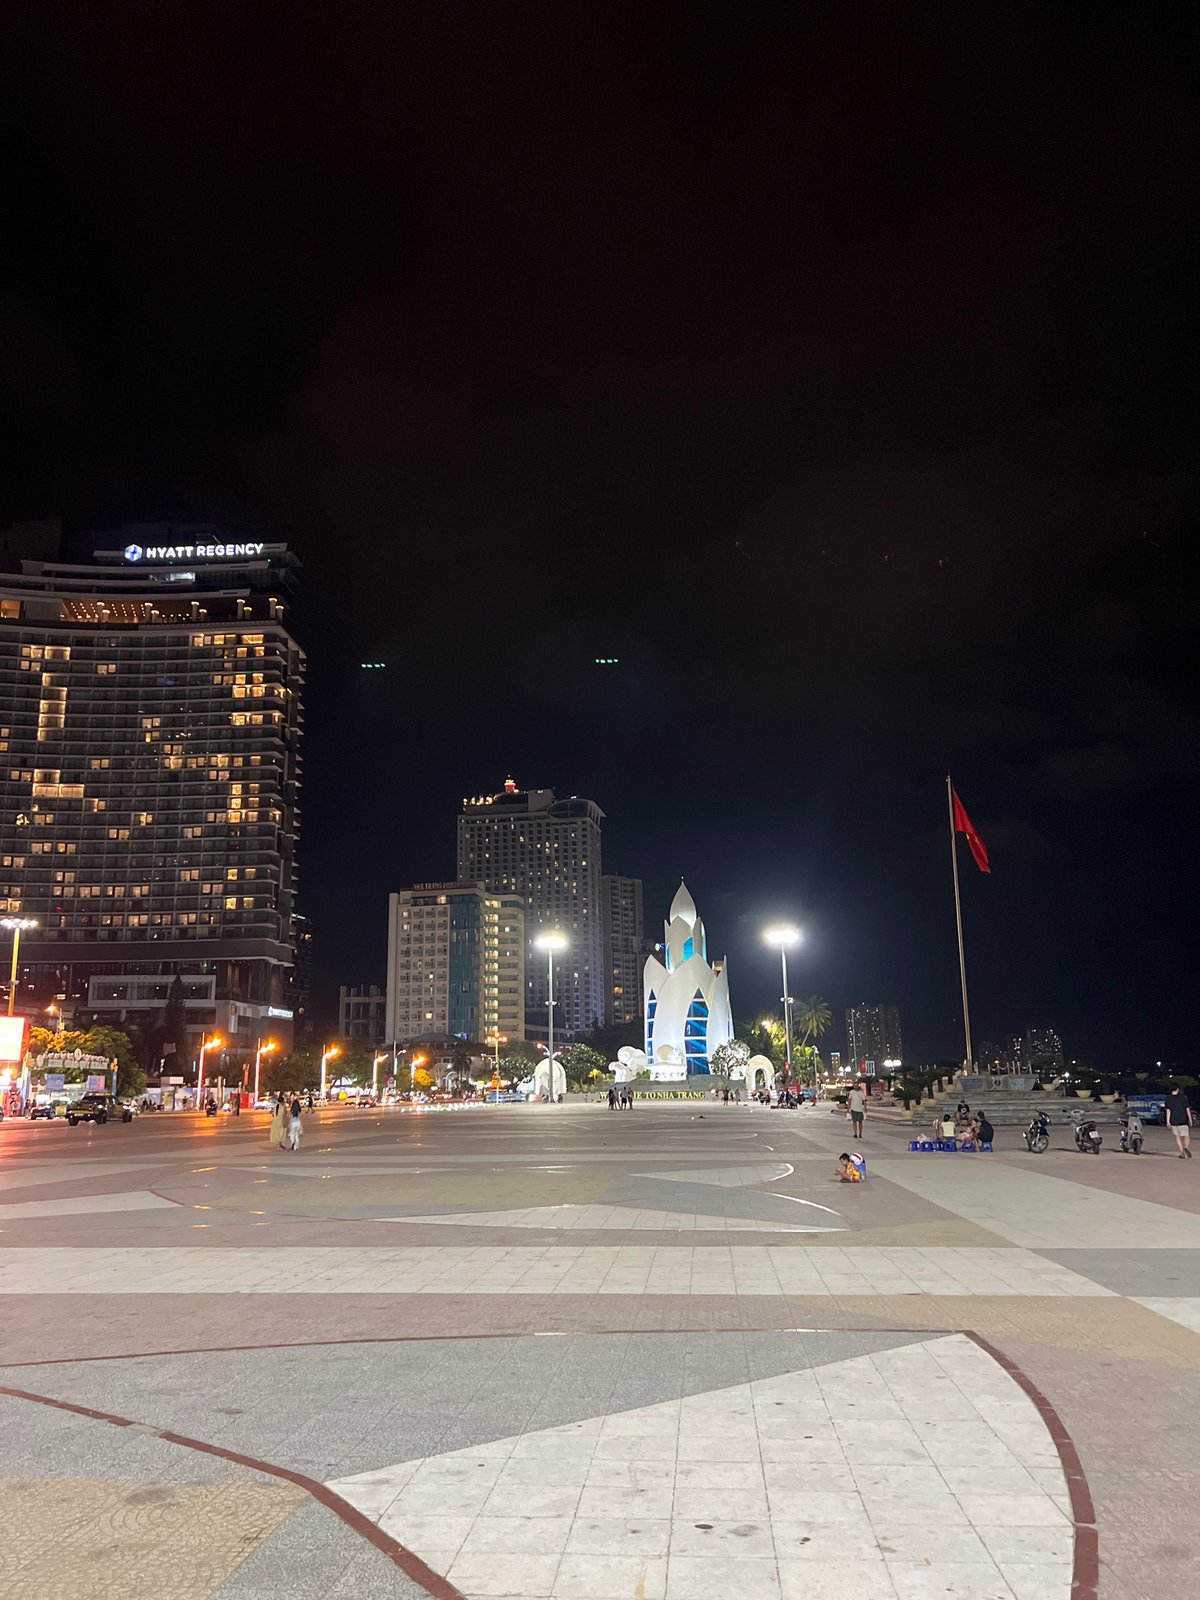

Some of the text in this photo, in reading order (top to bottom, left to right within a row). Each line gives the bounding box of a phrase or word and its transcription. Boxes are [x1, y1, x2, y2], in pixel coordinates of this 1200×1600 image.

[146, 543, 264, 559] HYATT REGENCY
[645, 1091, 656, 1099] TO
[656, 1091, 675, 1099] NHA
[676, 1091, 705, 1099] TRANG
